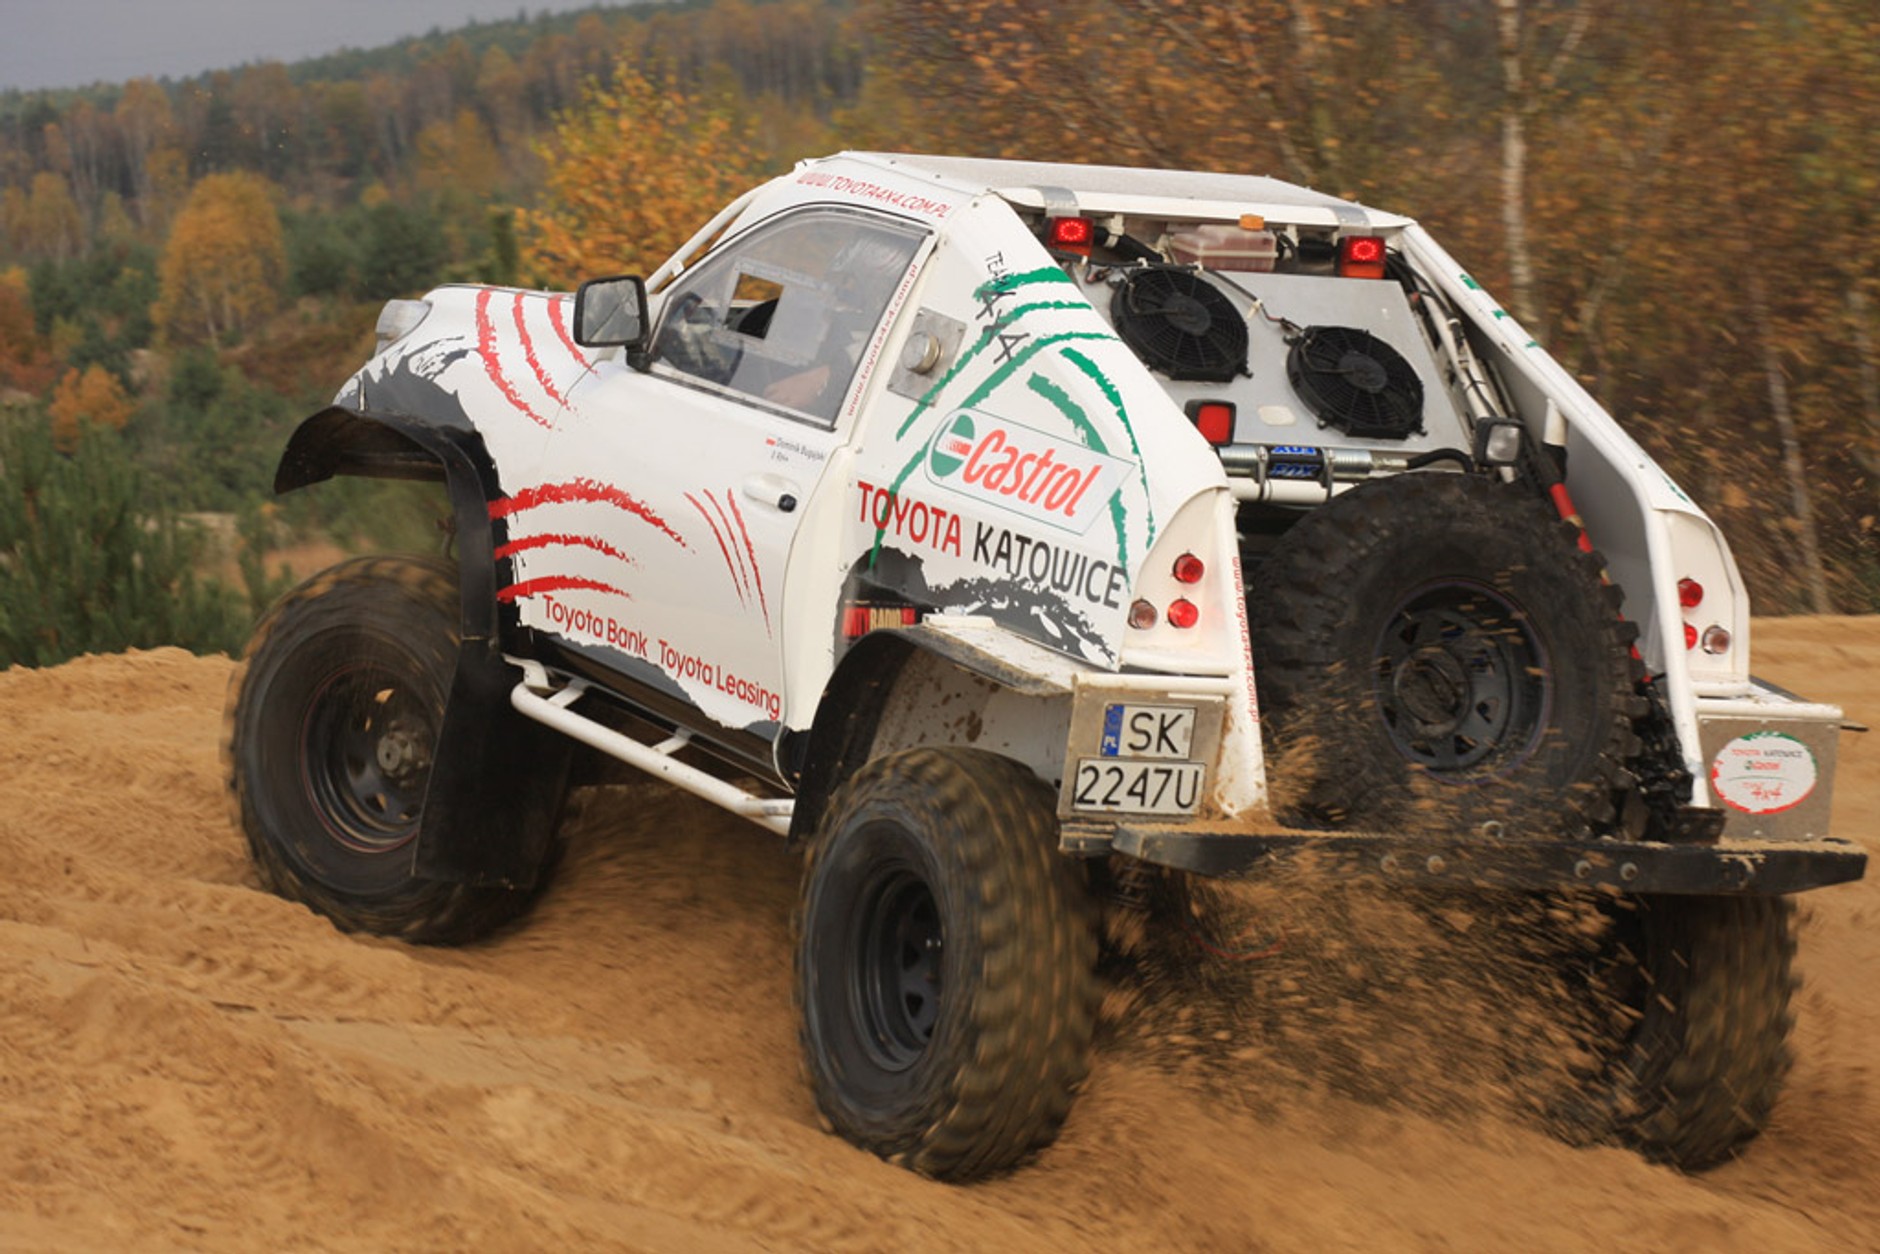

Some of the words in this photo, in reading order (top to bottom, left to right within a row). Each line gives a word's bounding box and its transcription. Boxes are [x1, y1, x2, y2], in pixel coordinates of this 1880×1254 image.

[963, 429, 1102, 517] Castrol
[858, 480, 961, 557] TOYOTA
[973, 521, 1127, 609] KATOWICE
[543, 595, 604, 638] Toyota
[607, 618, 648, 657] Bank
[658, 639, 713, 686] Toyota
[716, 665, 781, 721] Leasing
[1127, 712, 1184, 754] SK
[1075, 765, 1199, 809] 2247U
